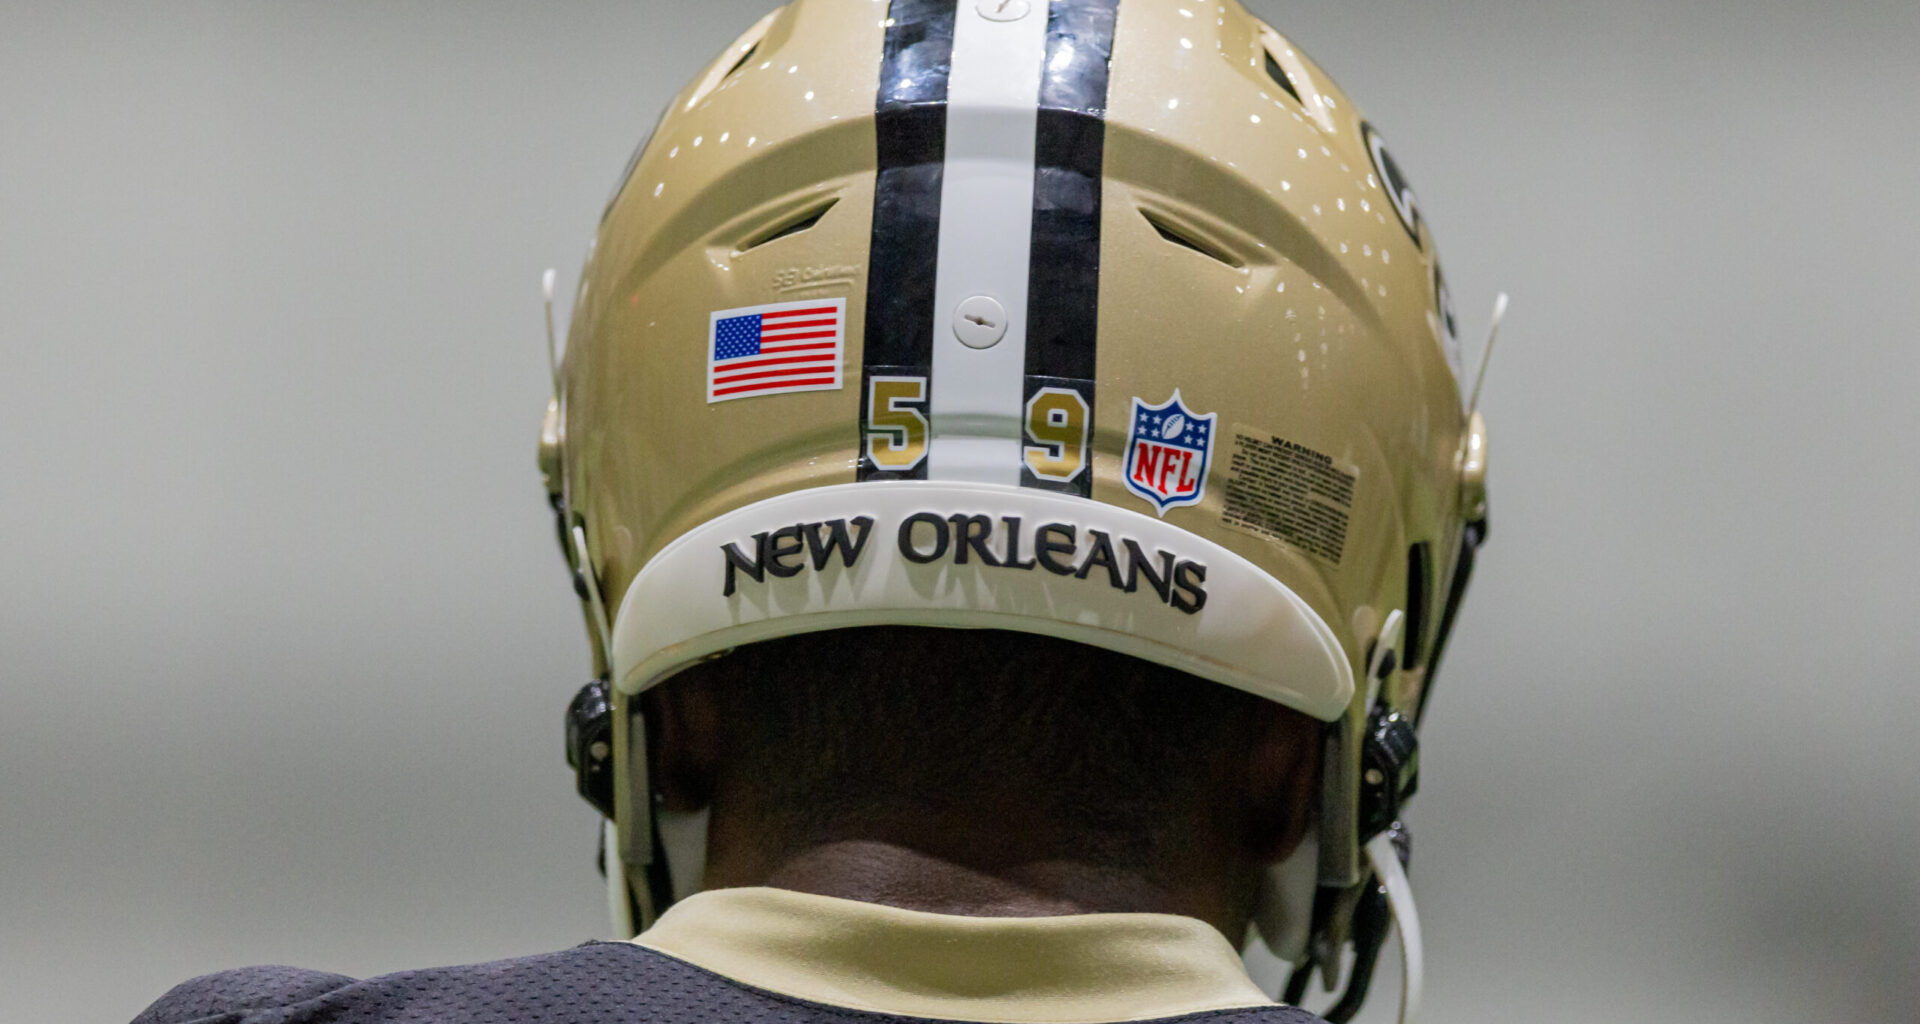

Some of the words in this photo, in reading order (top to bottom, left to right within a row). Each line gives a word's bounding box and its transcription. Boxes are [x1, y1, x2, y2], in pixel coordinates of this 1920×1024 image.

[868, 376, 929, 471] 5
[1024, 387, 1090, 483] 9
[1133, 441, 1195, 494] NFL
[1271, 436, 1333, 465] WARNING
[721, 516, 874, 597] NEW
[898, 512, 1207, 615] ORLEANS
